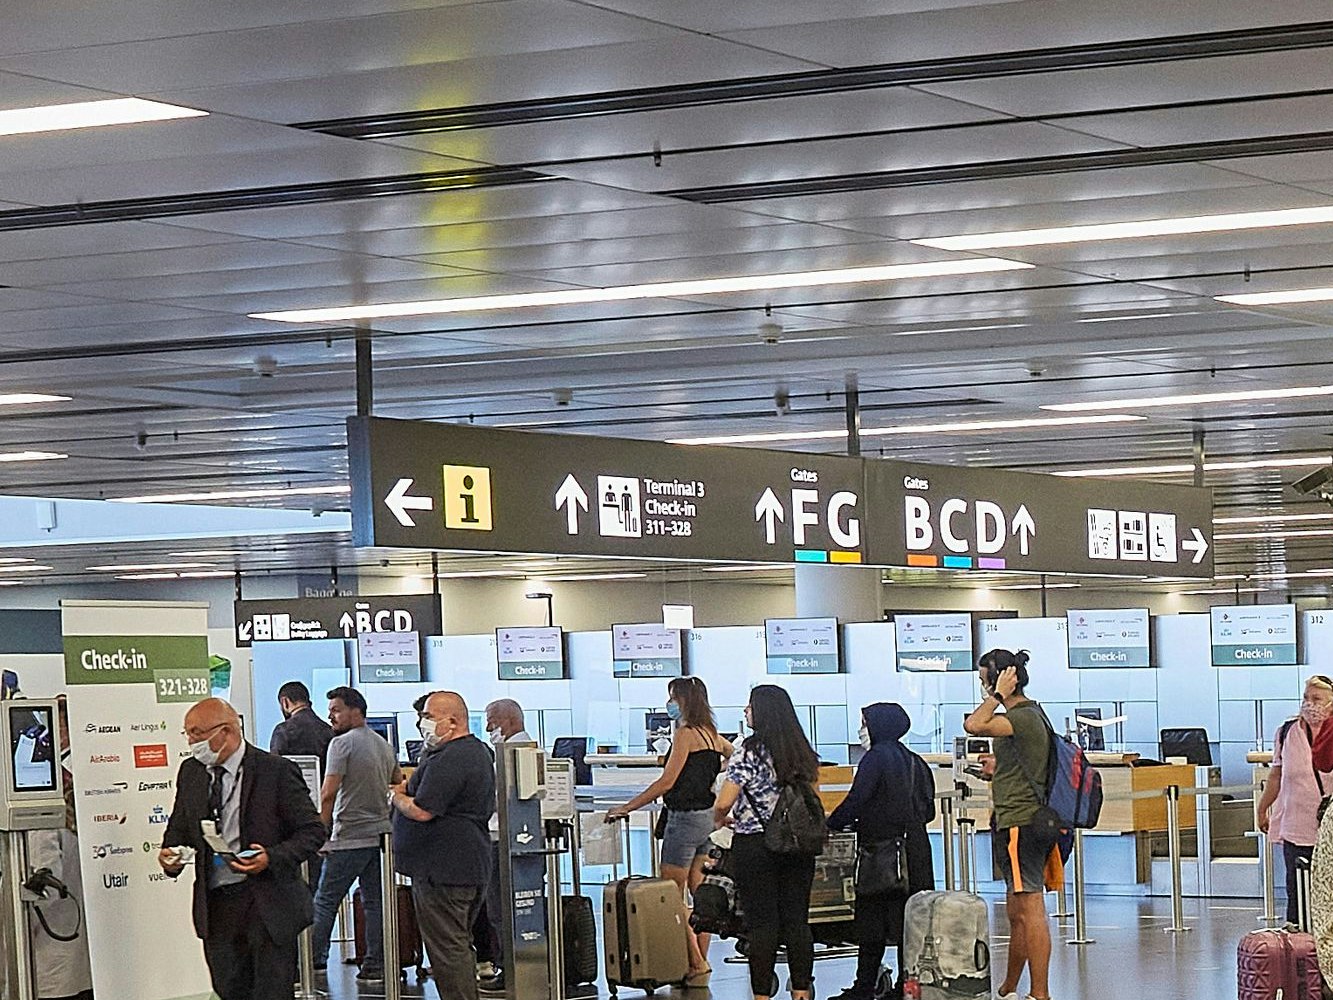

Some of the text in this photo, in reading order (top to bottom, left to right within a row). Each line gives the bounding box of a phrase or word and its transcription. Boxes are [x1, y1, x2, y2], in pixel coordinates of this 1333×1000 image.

[790, 467, 818, 483] Gates
[904, 475, 929, 491] Gates
[643, 478, 705, 498] Terminal 3
[645, 499, 697, 517] Check-in
[356, 610, 413, 632] BCD
[1311, 614, 1324, 624] 312
[81, 648, 148, 670] Check-in
[1090, 651, 1127, 661] Check-in
[1234, 648, 1273, 659] Check-in
[375, 668, 404, 678] Check-in
[514, 665, 546, 675] Check-in
[632, 661, 663, 671] Check-in
[159, 678, 208, 696] 321-328
[149, 815, 168, 824] KLM
[103, 872, 129, 889] Utair
